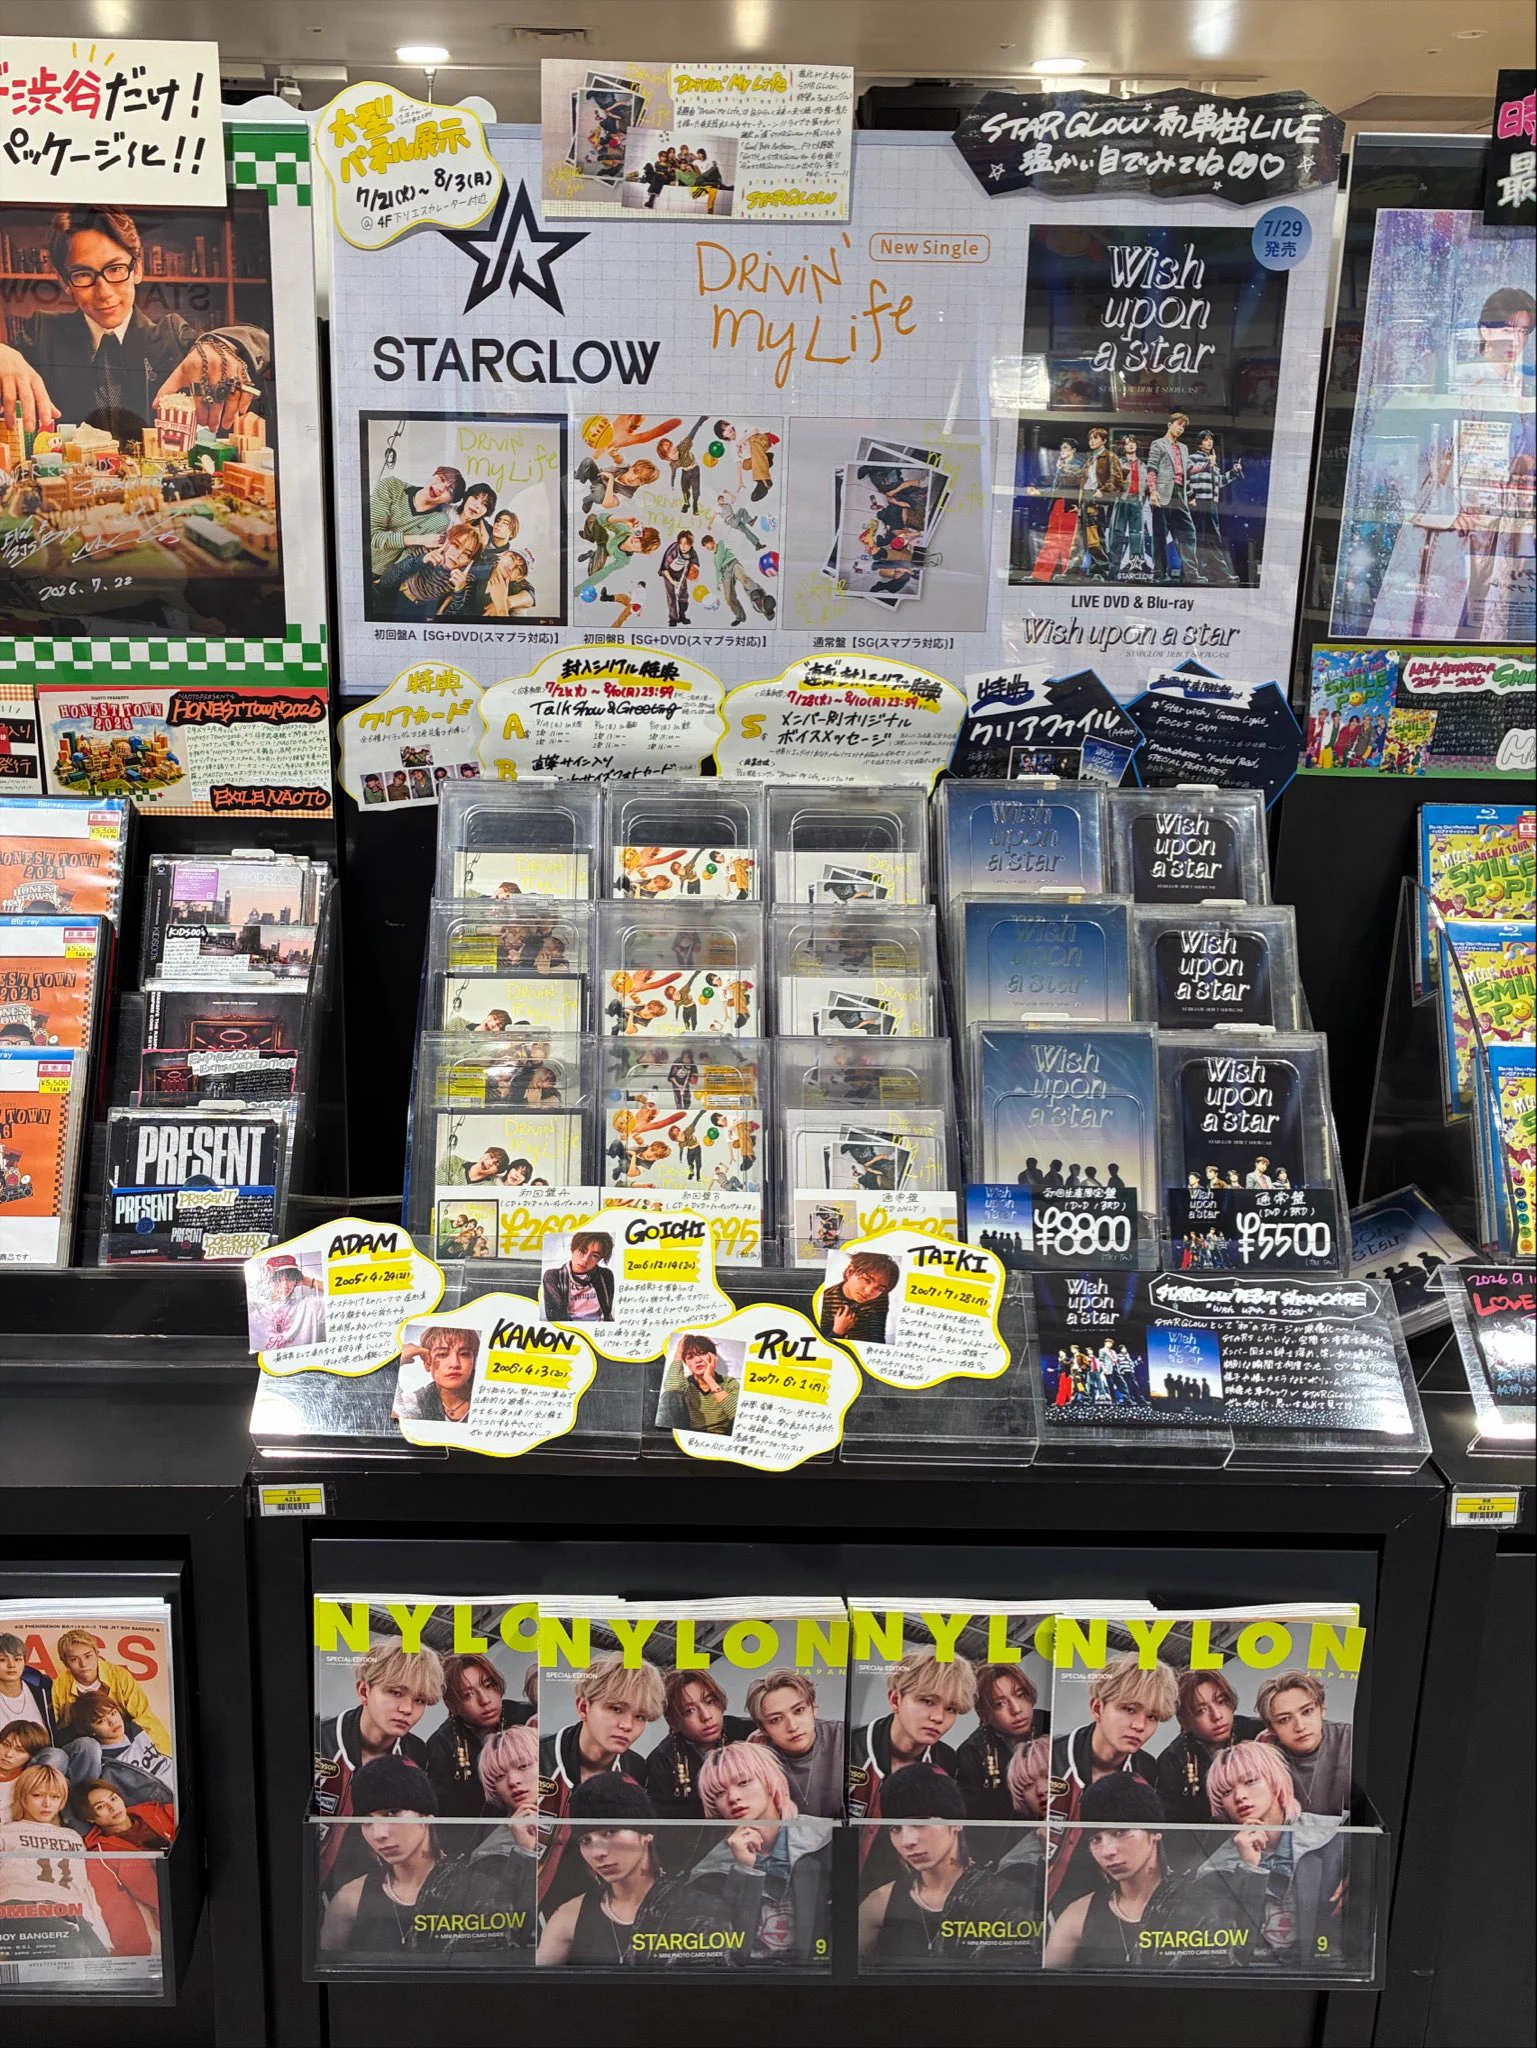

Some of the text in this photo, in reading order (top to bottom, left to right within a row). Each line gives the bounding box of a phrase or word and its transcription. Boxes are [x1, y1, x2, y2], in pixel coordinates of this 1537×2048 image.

[328, 95, 395, 148] 大型
[340, 117, 471, 183] パネル展示
[745, 187, 837, 210] STARGLOW
[1263, 220, 1303, 240] 7/29
[880, 239, 979, 259] New Single
[1264, 240, 1297, 258] 発売
[1106, 243, 1204, 290] Wish
[1101, 296, 1211, 340] upon
[372, 335, 661, 386] STARGLOW
[1121, 331, 1216, 374] star
[1071, 595, 1195, 612] LIVE DVD & Blu-ray
[1021, 616, 1084, 645] Wish
[1087, 622, 1158, 652] upon
[1183, 617, 1241, 647] star
[406, 669, 464, 697] 特典
[59, 702, 163, 718] HONEST TOWN
[282, 700, 322, 720] 2026
[359, 699, 474, 731] クリアカード
[530, 700, 572, 716] Talk
[93, 716, 133, 731] 2026
[503, 713, 525, 740] A
[741, 714, 767, 739] S
[1156, 716, 1218, 733] FOCUS CAM
[778, 730, 893, 746] ボイスメッセージ
[213, 788, 265, 807] EXILE
[1153, 812, 1211, 836] Wish
[1153, 836, 1217, 861] upon
[1170, 857, 1223, 880] star
[1448, 854, 1537, 889] SMILE
[11, 918, 40, 926] Blu-ray
[1178, 930, 1238, 955] Wish
[1179, 955, 1245, 982] upon
[31, 973, 77, 988] TOWN
[1196, 978, 1251, 1001] star
[1030, 1042, 1100, 1076] Wish
[1202, 1056, 1267, 1085] Wish
[1031, 1075, 1107, 1108] upon
[1203, 1086, 1273, 1116] upon
[5, 1109, 51, 1124] TOWN
[1050, 1102, 1114, 1129] star
[1223, 1108, 1281, 1134] star
[136, 1125, 266, 1186] PRESENT
[115, 1193, 176, 1225] PRESENT
[1255, 1190, 1307, 1206] 通常盤
[171, 1228, 204, 1243] PRESENT
[1033, 1206, 1133, 1257] ¥8800
[1236, 1211, 1331, 1265] ¥5500
[328, 1232, 398, 1258] ADAM
[907, 1245, 989, 1273] TAIKI
[1065, 1277, 1109, 1296] Wish
[1067, 1294, 1115, 1312] upon
[1081, 1310, 1120, 1325] star
[488, 1318, 575, 1352] KANON
[319, 1602, 539, 1654] NYLO
[539, 1616, 850, 1669] NYLON
[1055, 1618, 1367, 1672] NYLON
[326, 1656, 378, 1664] SPECIAL EDITION
[858, 1664, 911, 1672] SPECIAL EDITION
[545, 1672, 598, 1680] SPECIAL EDITION
[794, 1667, 848, 1677] JAPAN
[1061, 1672, 1113, 1680] SPECIAL EDITION
[1306, 1671, 1360, 1681] JAPAN
[413, 1912, 526, 1933] STARGLOW
[19, 1931, 70, 1940] BANGERZ
[631, 1931, 746, 1952] STARGLOW
[815, 1938, 828, 1956] 9
[1138, 1929, 1250, 1950] STARGLOW
[1316, 1936, 1329, 1952] 9
